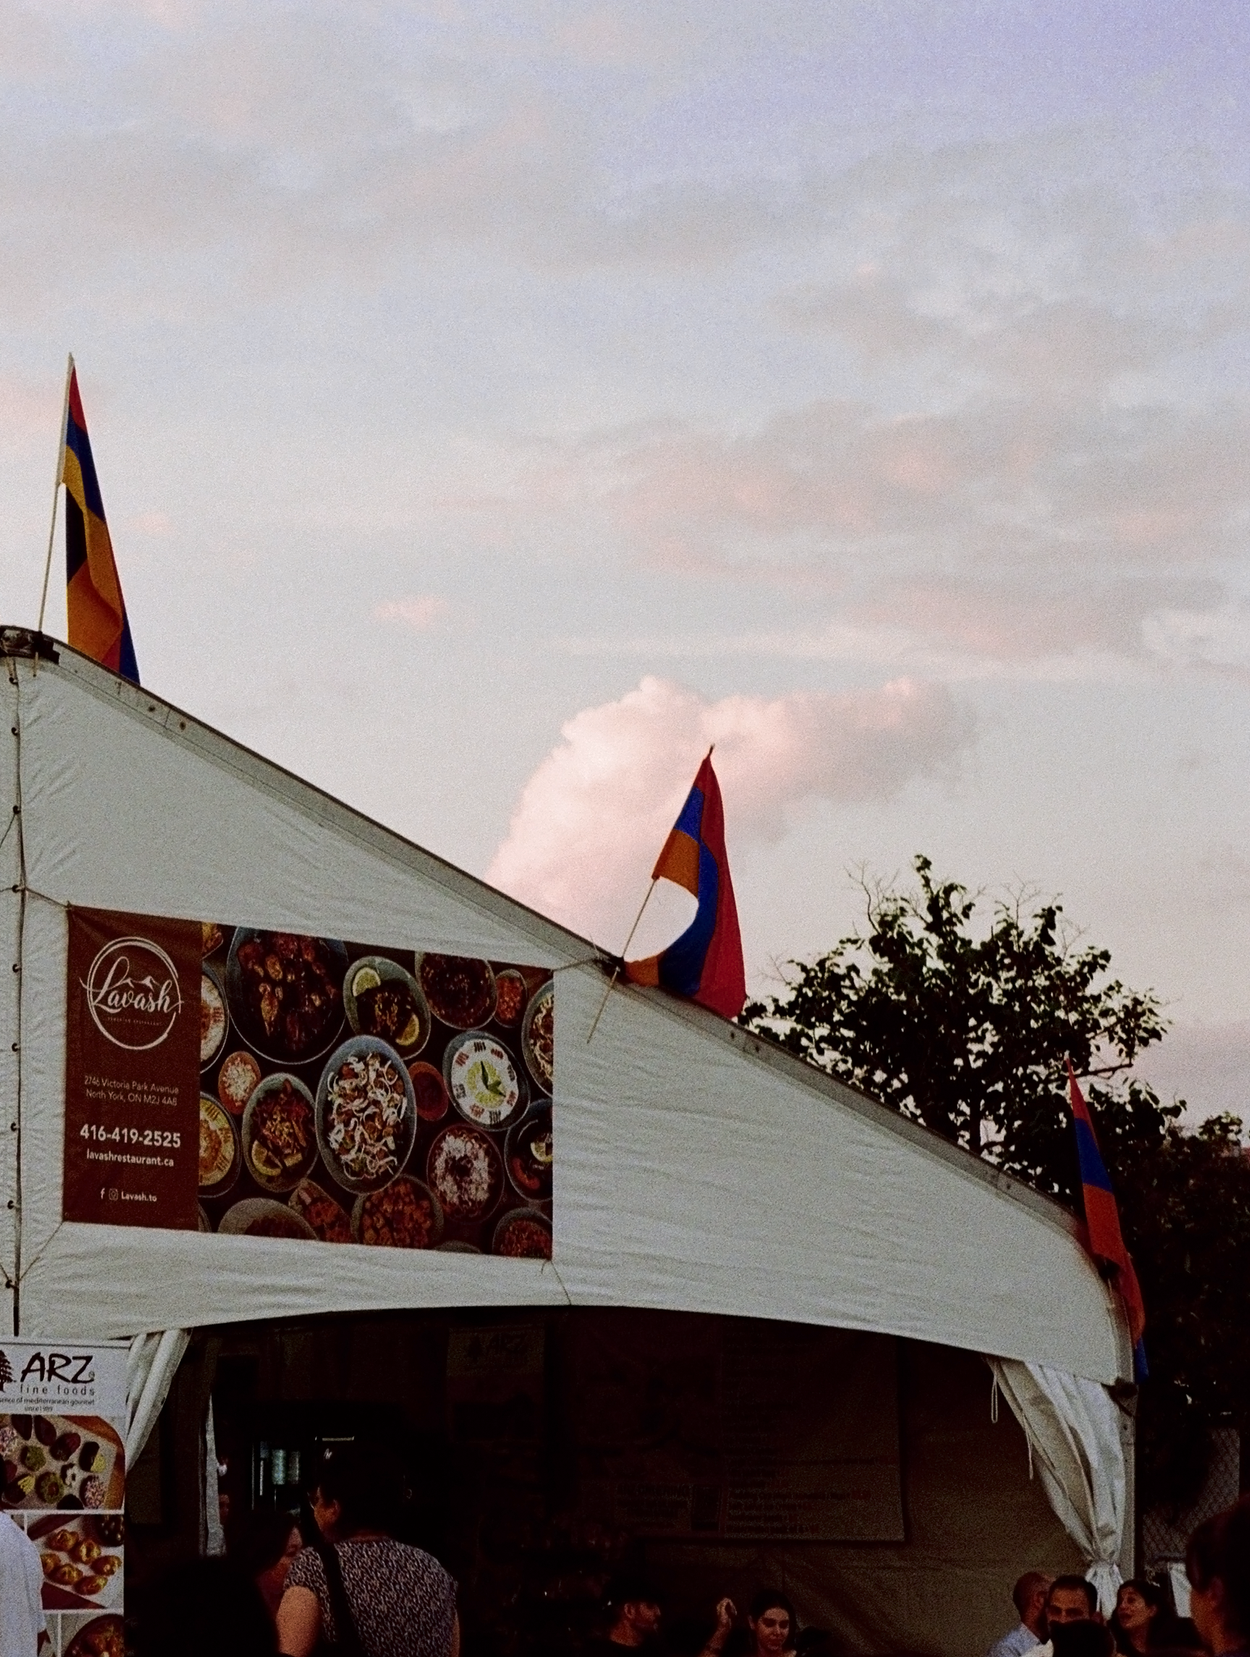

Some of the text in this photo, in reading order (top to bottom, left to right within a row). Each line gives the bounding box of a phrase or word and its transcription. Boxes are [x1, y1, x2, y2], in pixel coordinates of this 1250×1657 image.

[79, 955, 184, 1014] Lavash
[86, 1088, 106, 1099] North
[128, 1093, 143, 1103] ON
[101, 1077, 130, 1090] Victoria
[132, 1080, 148, 1092] Park
[150, 1083, 179, 1095] Avenue
[79, 1123, 181, 1148] 416-419-2525
[86, 1148, 174, 1167] lavashrestaurant.ca
[20, 1351, 95, 1384] ARZ
[20, 1384, 95, 1396] fine foods
